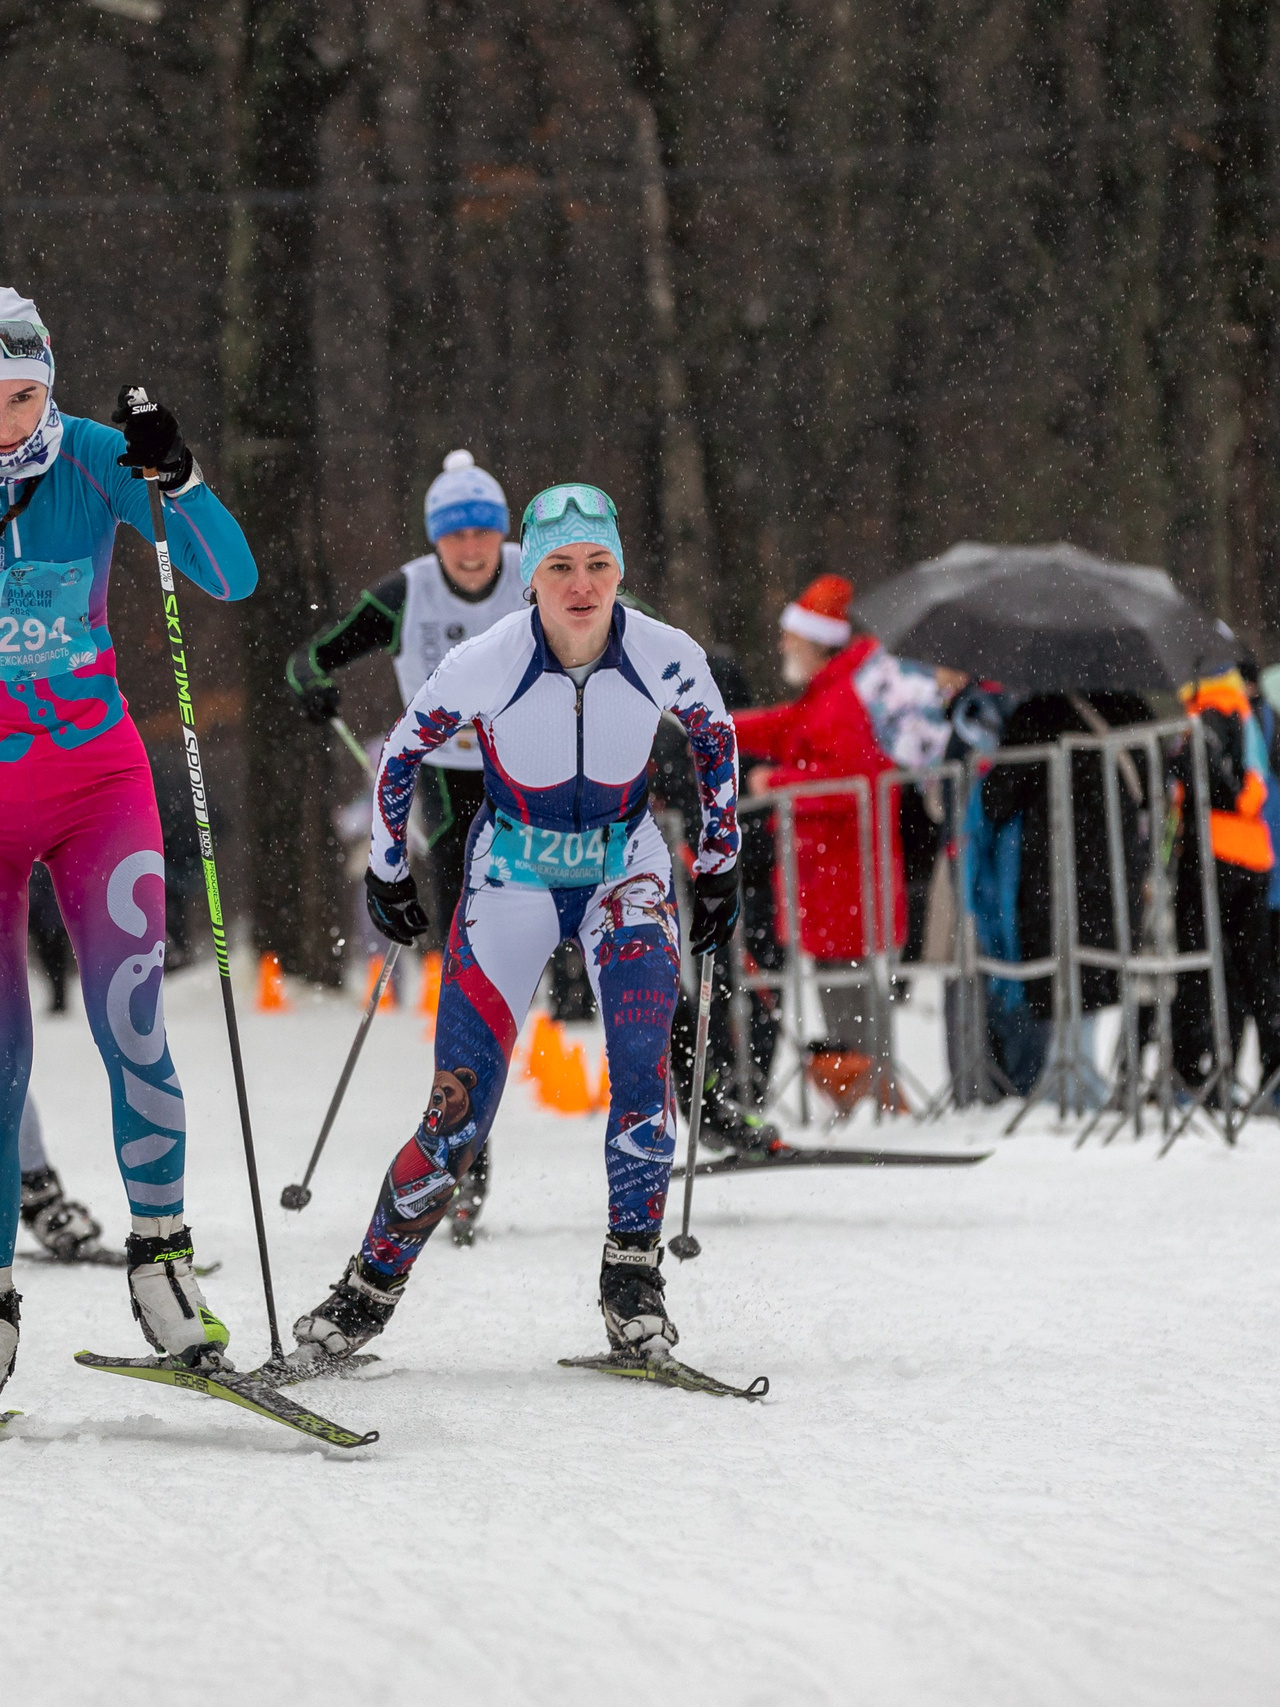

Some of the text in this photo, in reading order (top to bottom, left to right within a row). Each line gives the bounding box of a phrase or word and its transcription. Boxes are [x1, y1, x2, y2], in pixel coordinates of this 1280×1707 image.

[35, 648, 70, 664] ОБЛАСТЬ
[166, 593, 195, 725] SKI TIME
[519, 826, 605, 867] 1204
[515, 859, 571, 878] ВОРОНЕЖСКАЯ
[174, 1372, 210, 1394] FISCHER
